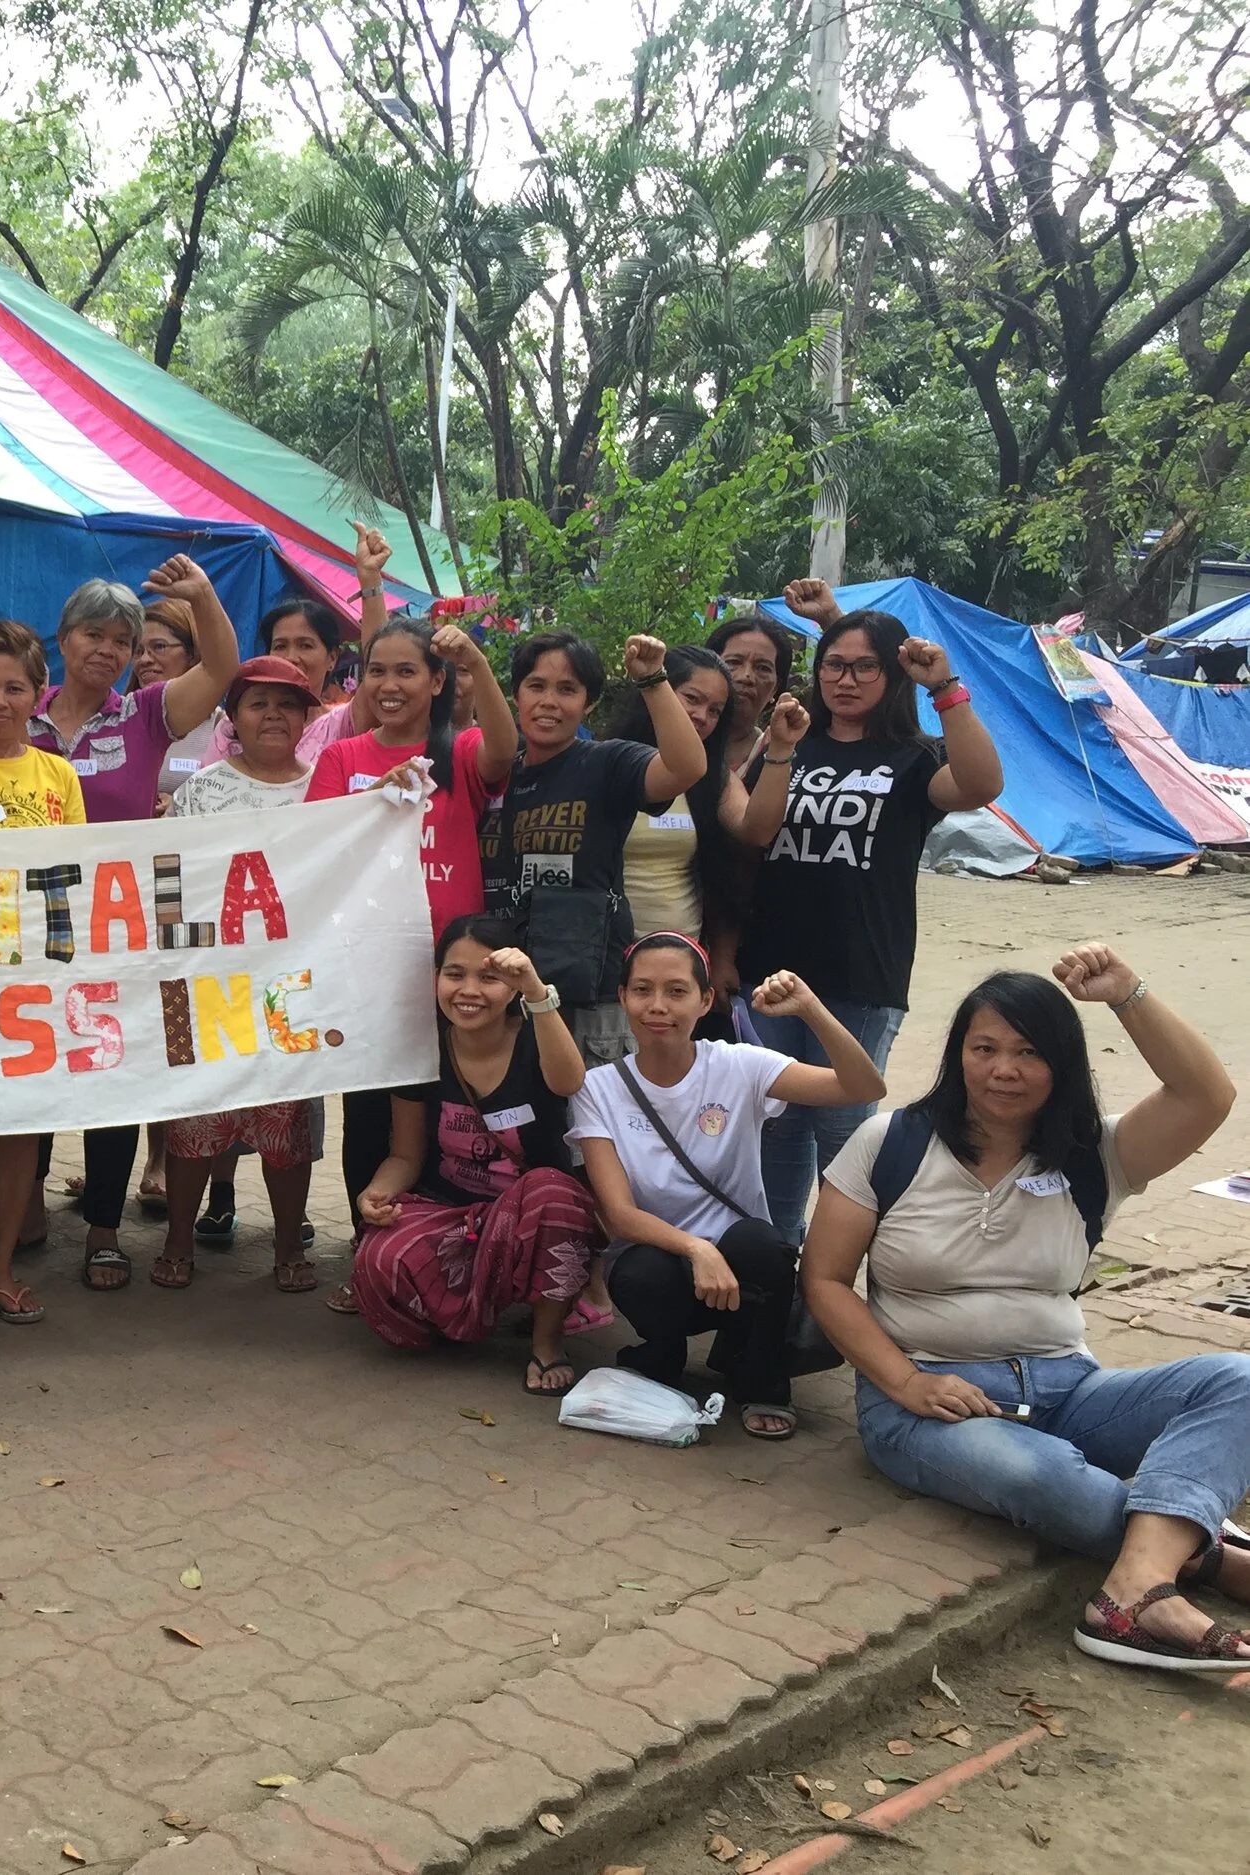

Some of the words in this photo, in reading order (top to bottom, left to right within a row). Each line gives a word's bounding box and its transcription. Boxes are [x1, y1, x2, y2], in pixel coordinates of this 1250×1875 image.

[484, 800, 587, 834] FREVER
[765, 828, 874, 870] ALA!
[159, 968, 345, 1068] INC.
[493, 1110, 518, 1127] TIN
